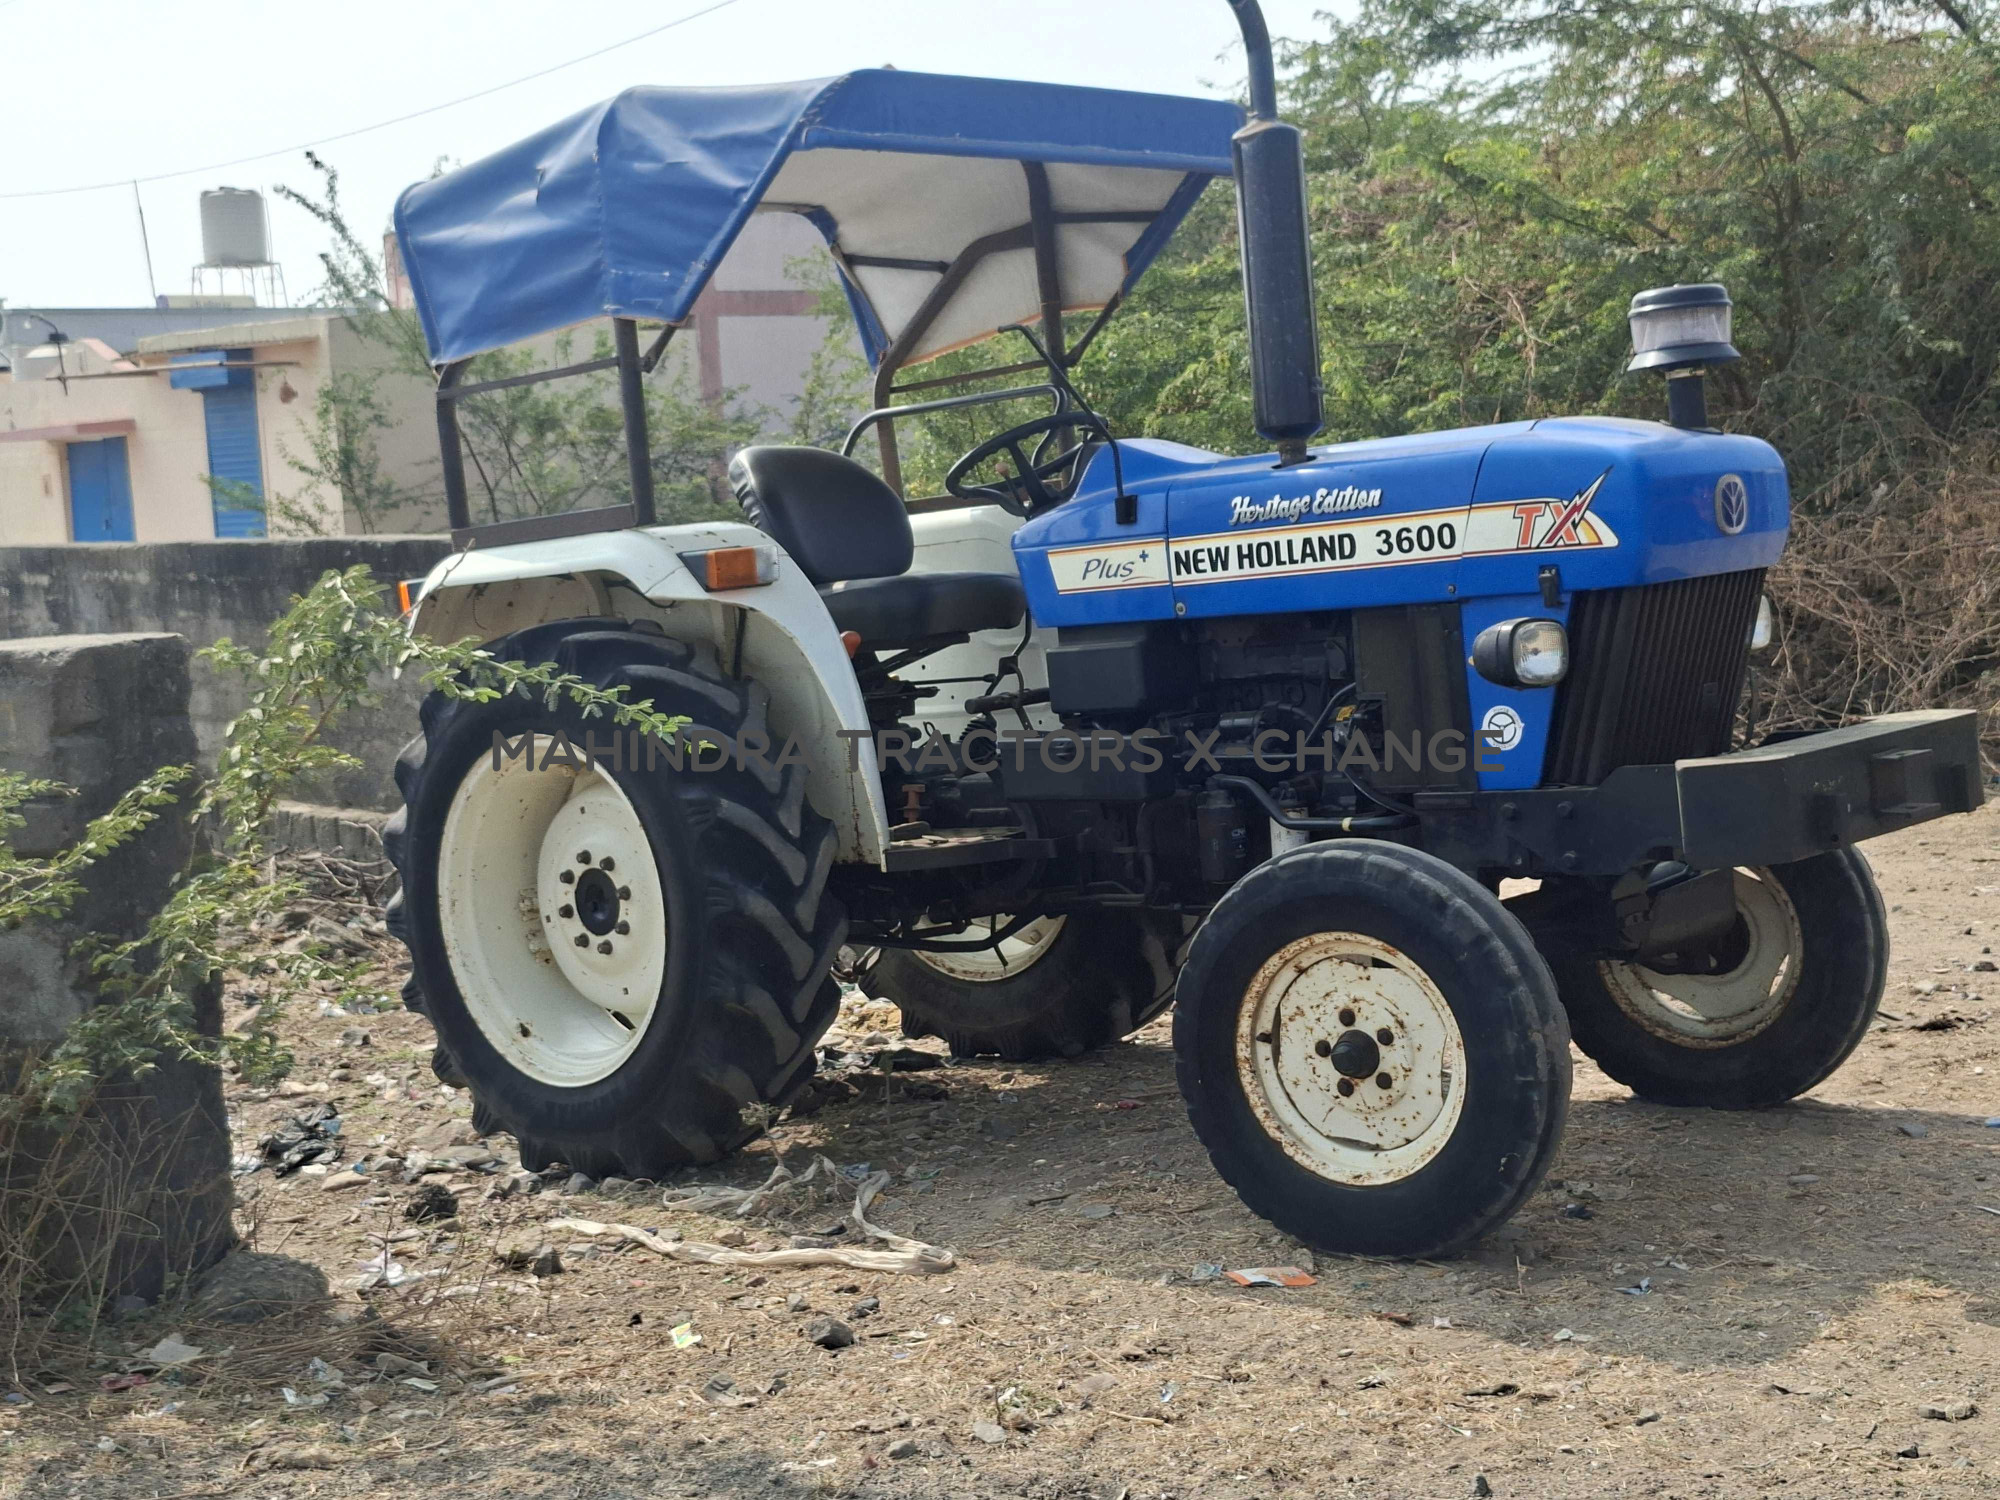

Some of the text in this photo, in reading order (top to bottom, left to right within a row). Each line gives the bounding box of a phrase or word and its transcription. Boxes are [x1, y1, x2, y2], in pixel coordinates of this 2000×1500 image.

[1229, 485, 1382, 526] Heritage Edition
[1513, 473, 1606, 549] TX
[1173, 522, 1457, 576] NEW HOLLAND 3600
